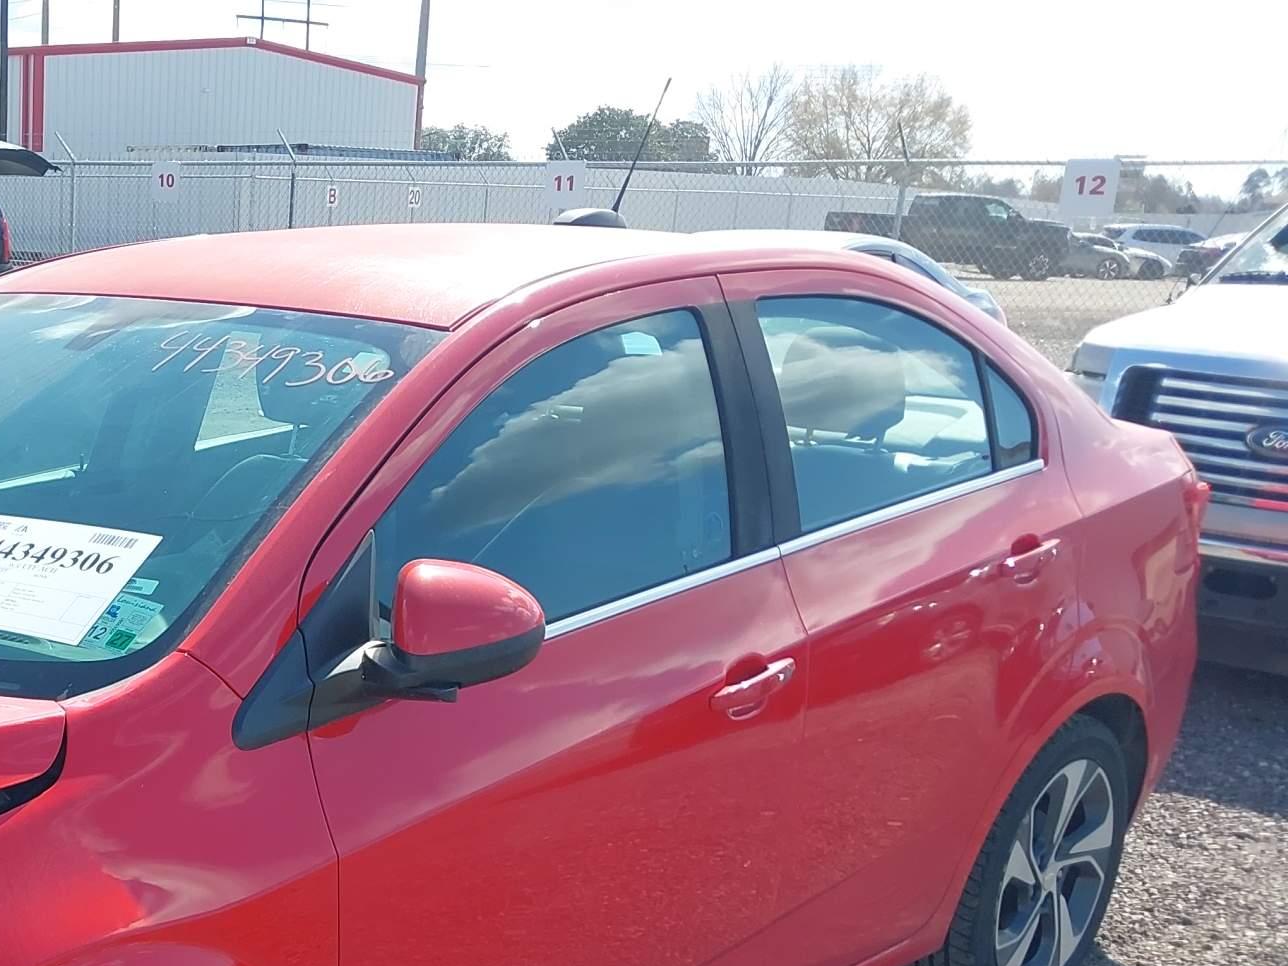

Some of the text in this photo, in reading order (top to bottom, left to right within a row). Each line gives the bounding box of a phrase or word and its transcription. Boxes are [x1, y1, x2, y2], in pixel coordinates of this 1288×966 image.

[158, 173, 175, 188] 10
[554, 175, 574, 192] 11
[1075, 175, 1107, 196] 12
[328, 188, 337, 205] B
[409, 190, 421, 206] 20
[152, 330, 395, 387] 44349306
[88, 625, 108, 640] 12
[112, 630, 132, 647] 27
